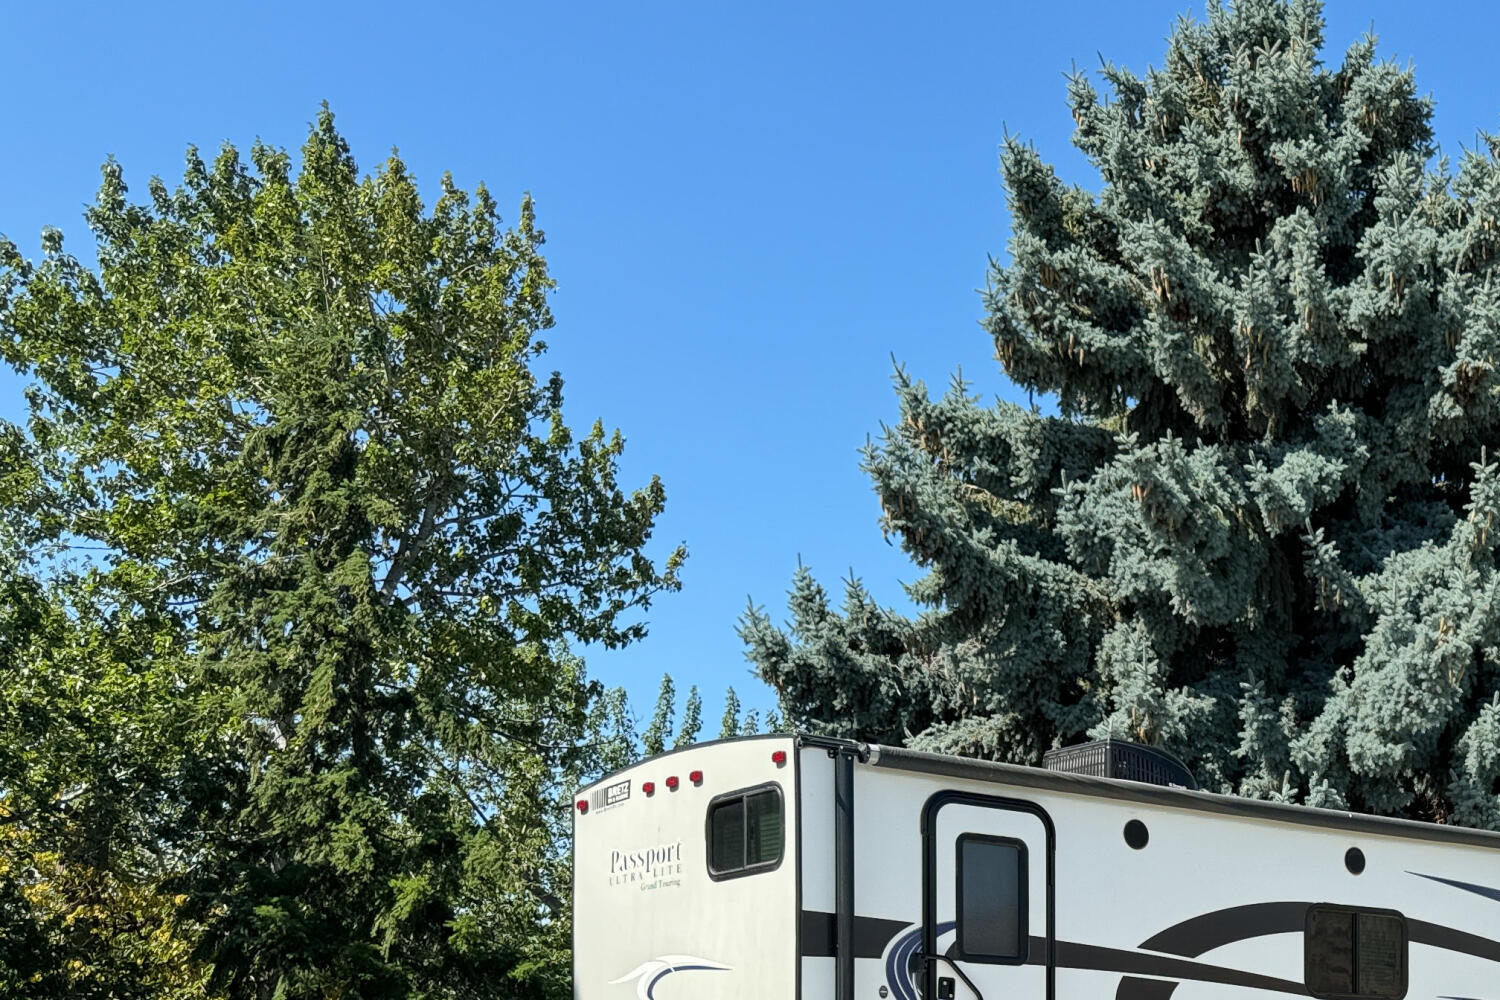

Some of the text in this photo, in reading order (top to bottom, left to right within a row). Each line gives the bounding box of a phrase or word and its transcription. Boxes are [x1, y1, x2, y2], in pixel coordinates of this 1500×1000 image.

[611, 841, 681, 873] Passport
[609, 863, 681, 888] ULTRA LITE
